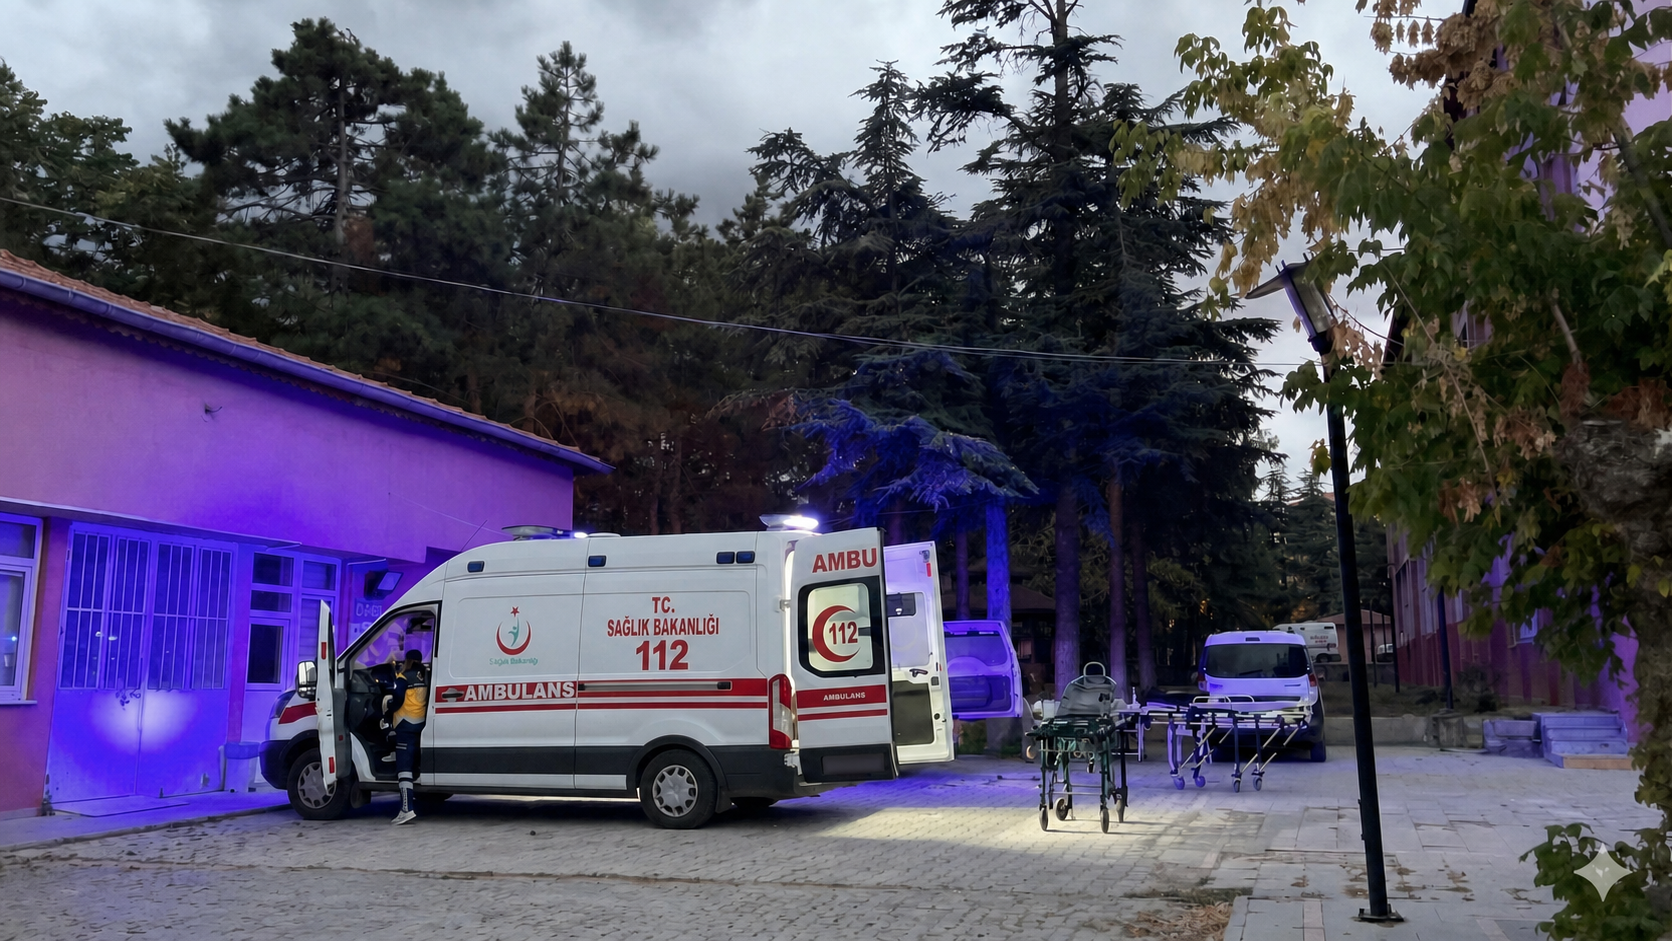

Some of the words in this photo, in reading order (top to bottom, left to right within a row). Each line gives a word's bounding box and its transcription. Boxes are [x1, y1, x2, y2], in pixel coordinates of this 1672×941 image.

[812, 548, 878, 573] AMBU
[607, 615, 650, 637] SAĞLIK
[653, 613, 720, 636] BAKANLIĞI
[829, 621, 859, 645] 112
[635, 639, 689, 671] 112
[463, 681, 576, 701] AMBULANS
[823, 692, 866, 701] AMBULANS
